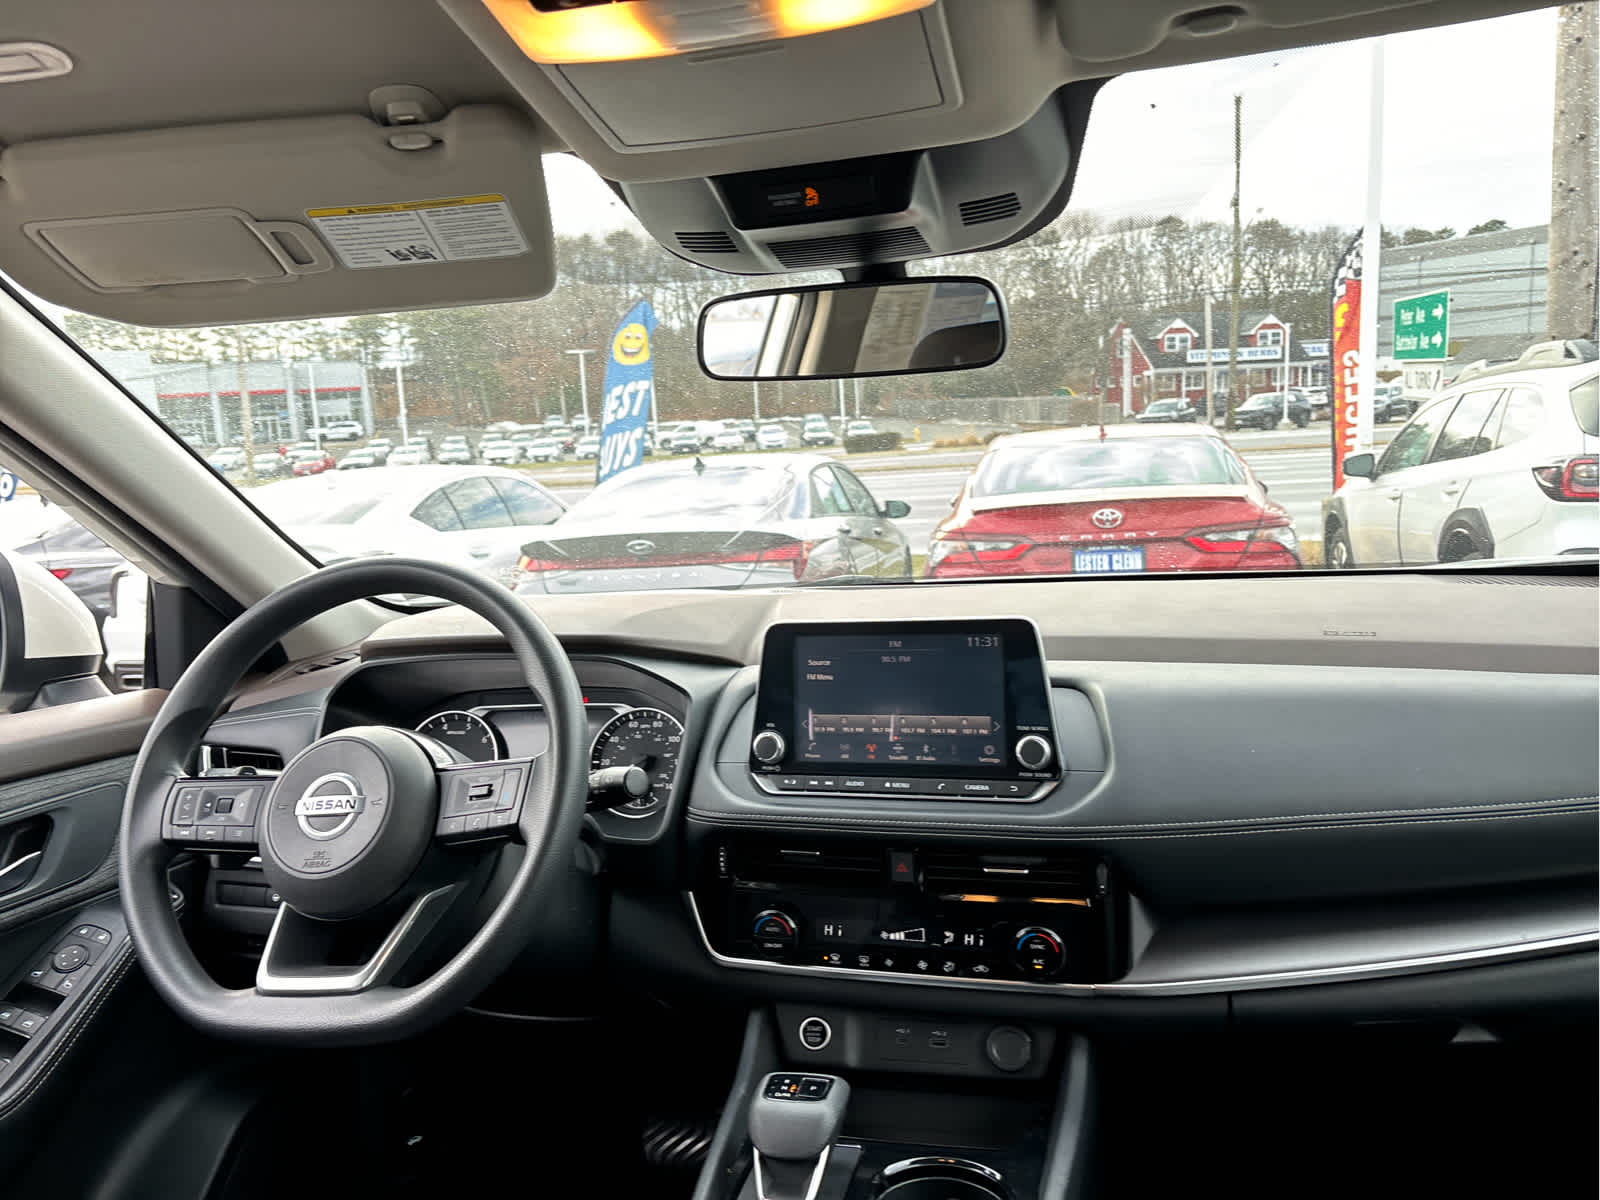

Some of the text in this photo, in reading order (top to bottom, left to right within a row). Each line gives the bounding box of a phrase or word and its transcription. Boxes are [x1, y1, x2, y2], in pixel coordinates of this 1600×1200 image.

[1074, 552, 1109, 573] LESTER
[967, 635, 999, 648] 11:31
[807, 659, 832, 667] Source
[628, 721, 639, 729] 60
[481, 736, 488, 744] 6
[302, 799, 357, 811] NISSAN
[823, 924, 843, 937] Hi
[963, 933, 984, 946] Hi
